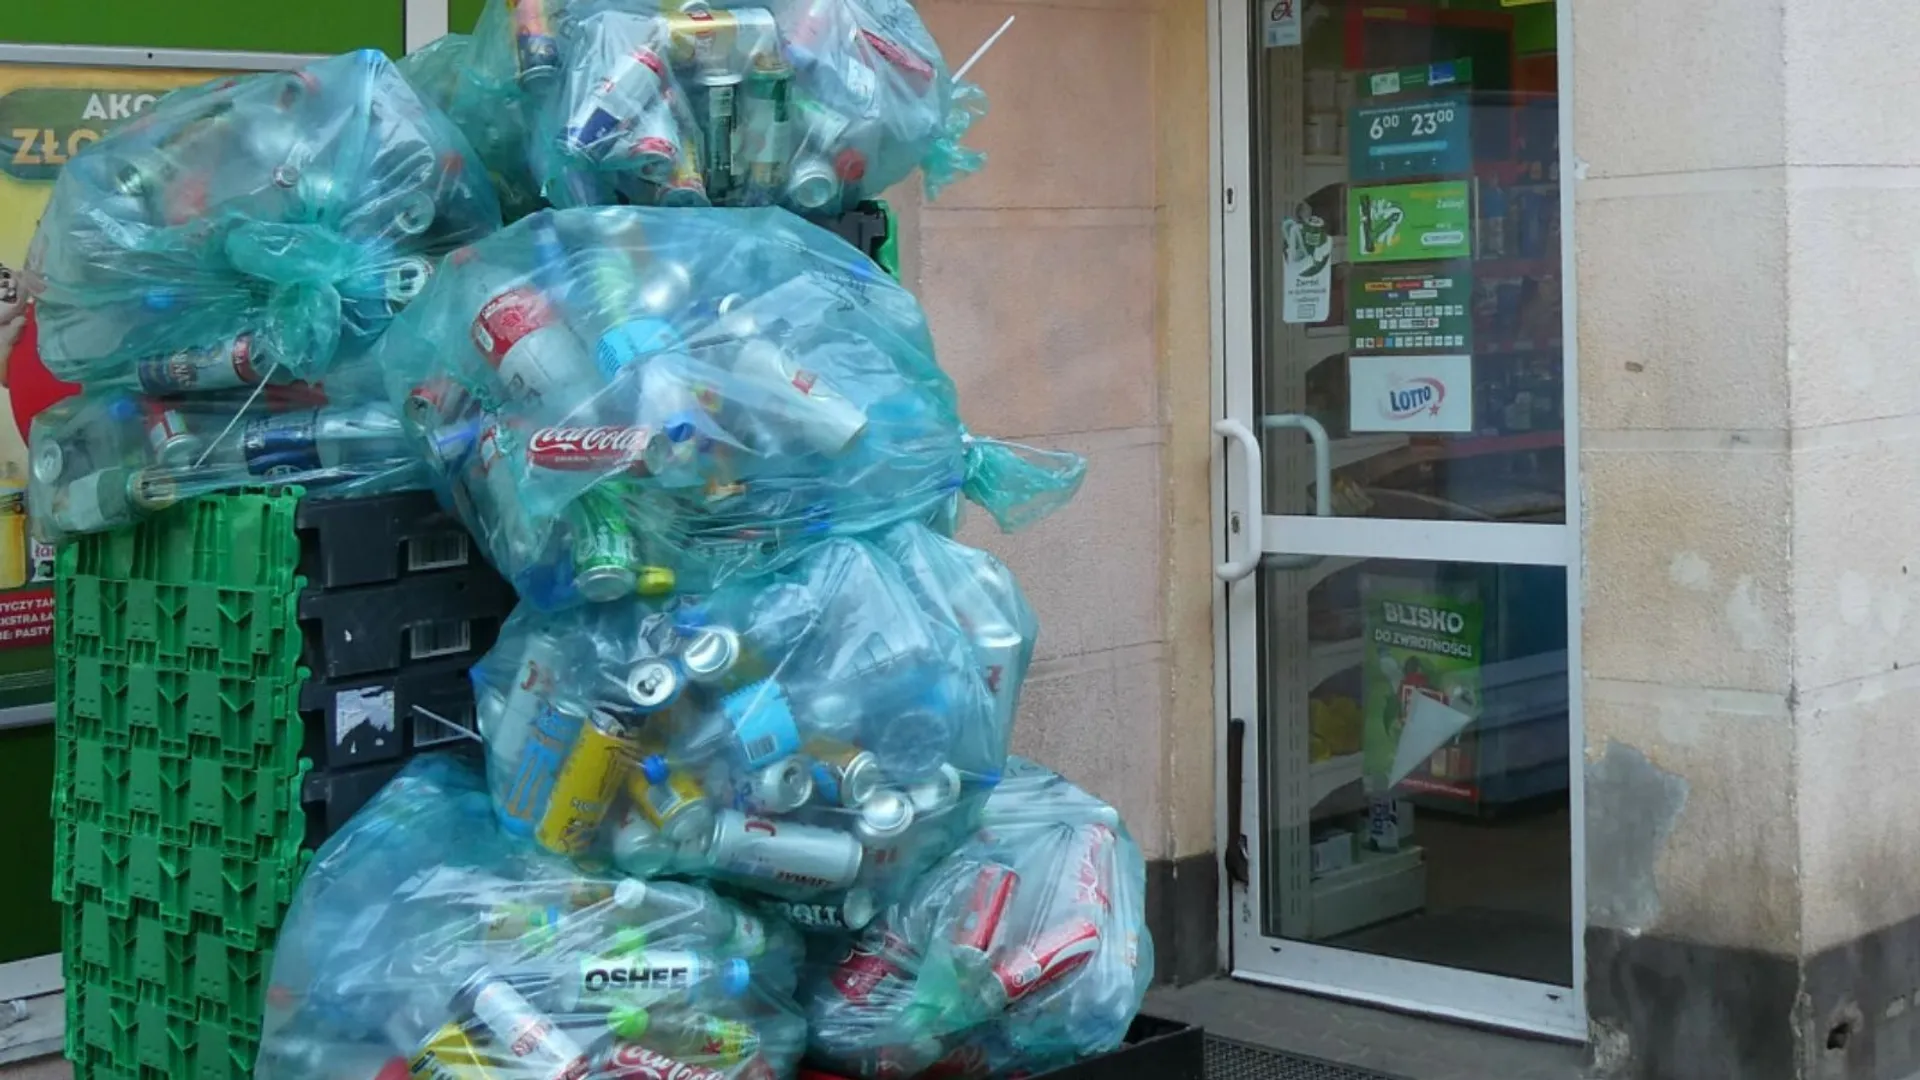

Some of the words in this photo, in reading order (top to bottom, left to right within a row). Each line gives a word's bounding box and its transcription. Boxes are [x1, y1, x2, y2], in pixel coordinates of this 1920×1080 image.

[1390, 385, 1432, 412] LOTTO
[1382, 602, 1464, 634] BLISKO
[15, 625, 51, 639] PASTY
[1375, 629, 1391, 642] DO
[585, 968, 689, 991] OSHEE
